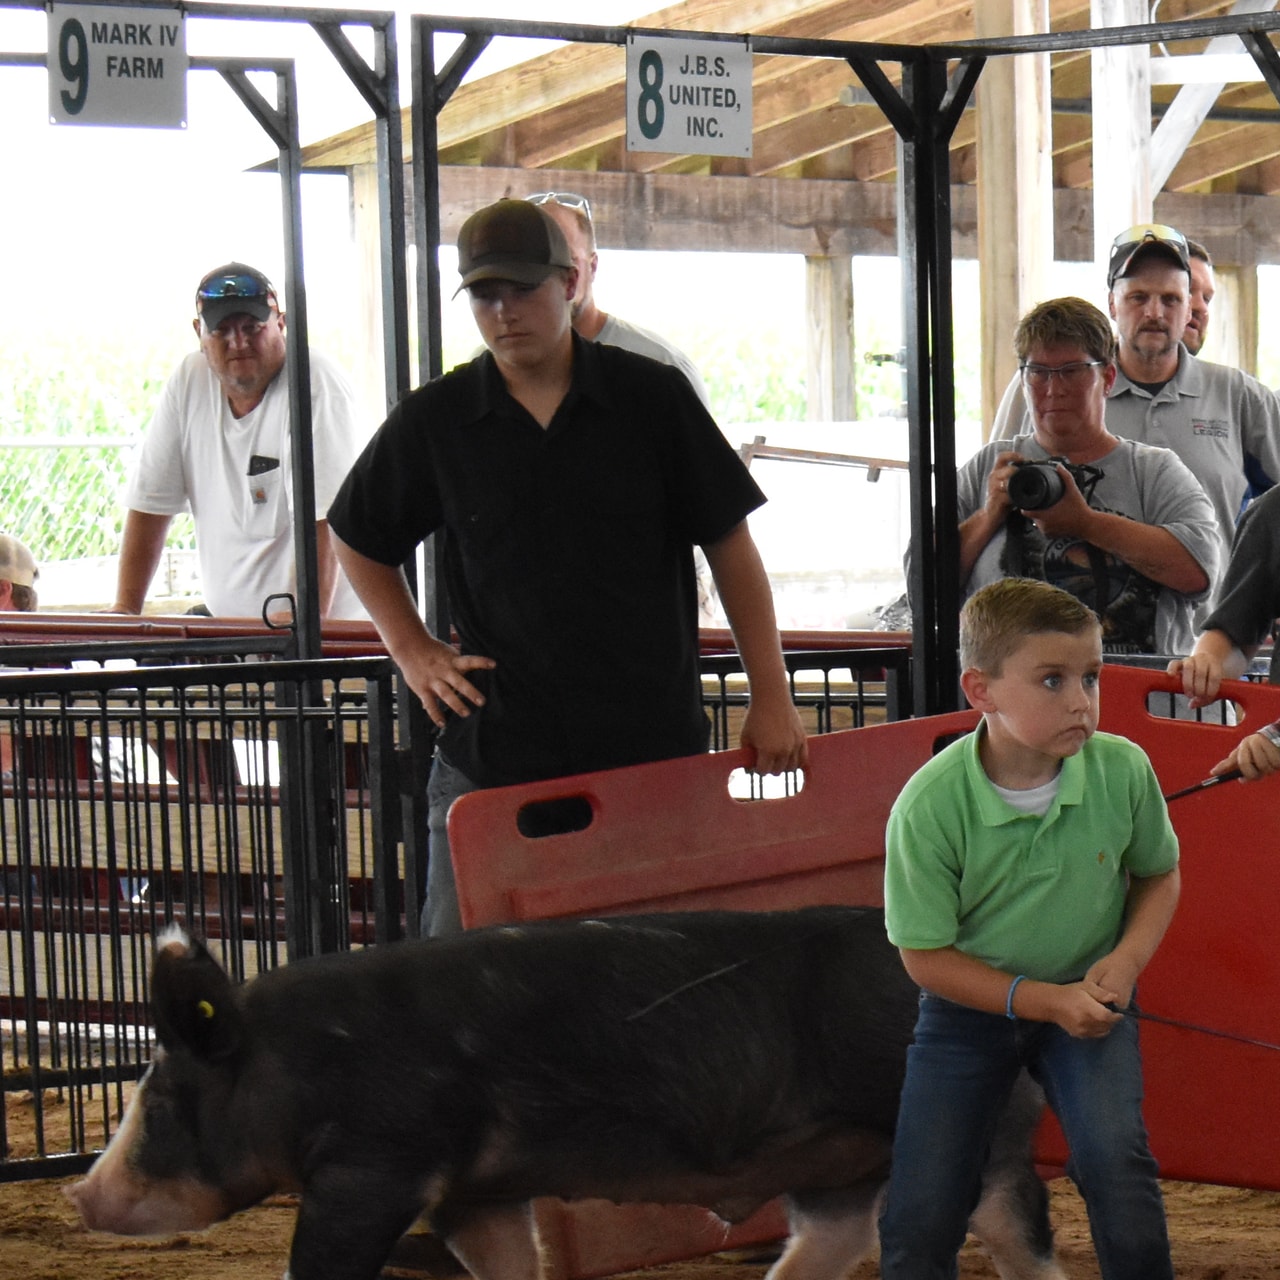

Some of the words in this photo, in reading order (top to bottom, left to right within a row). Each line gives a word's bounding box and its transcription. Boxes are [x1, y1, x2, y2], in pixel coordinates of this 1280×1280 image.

[91, 22, 152, 46] MARK
[160, 25, 178, 47] IV
[59, 18, 89, 115] 9
[106, 56, 164, 79] FARM
[680, 55, 730, 77] J.B.S.
[638, 49, 665, 139] 8
[669, 84, 741, 112] UNITED,
[686, 116, 724, 138] INC.
